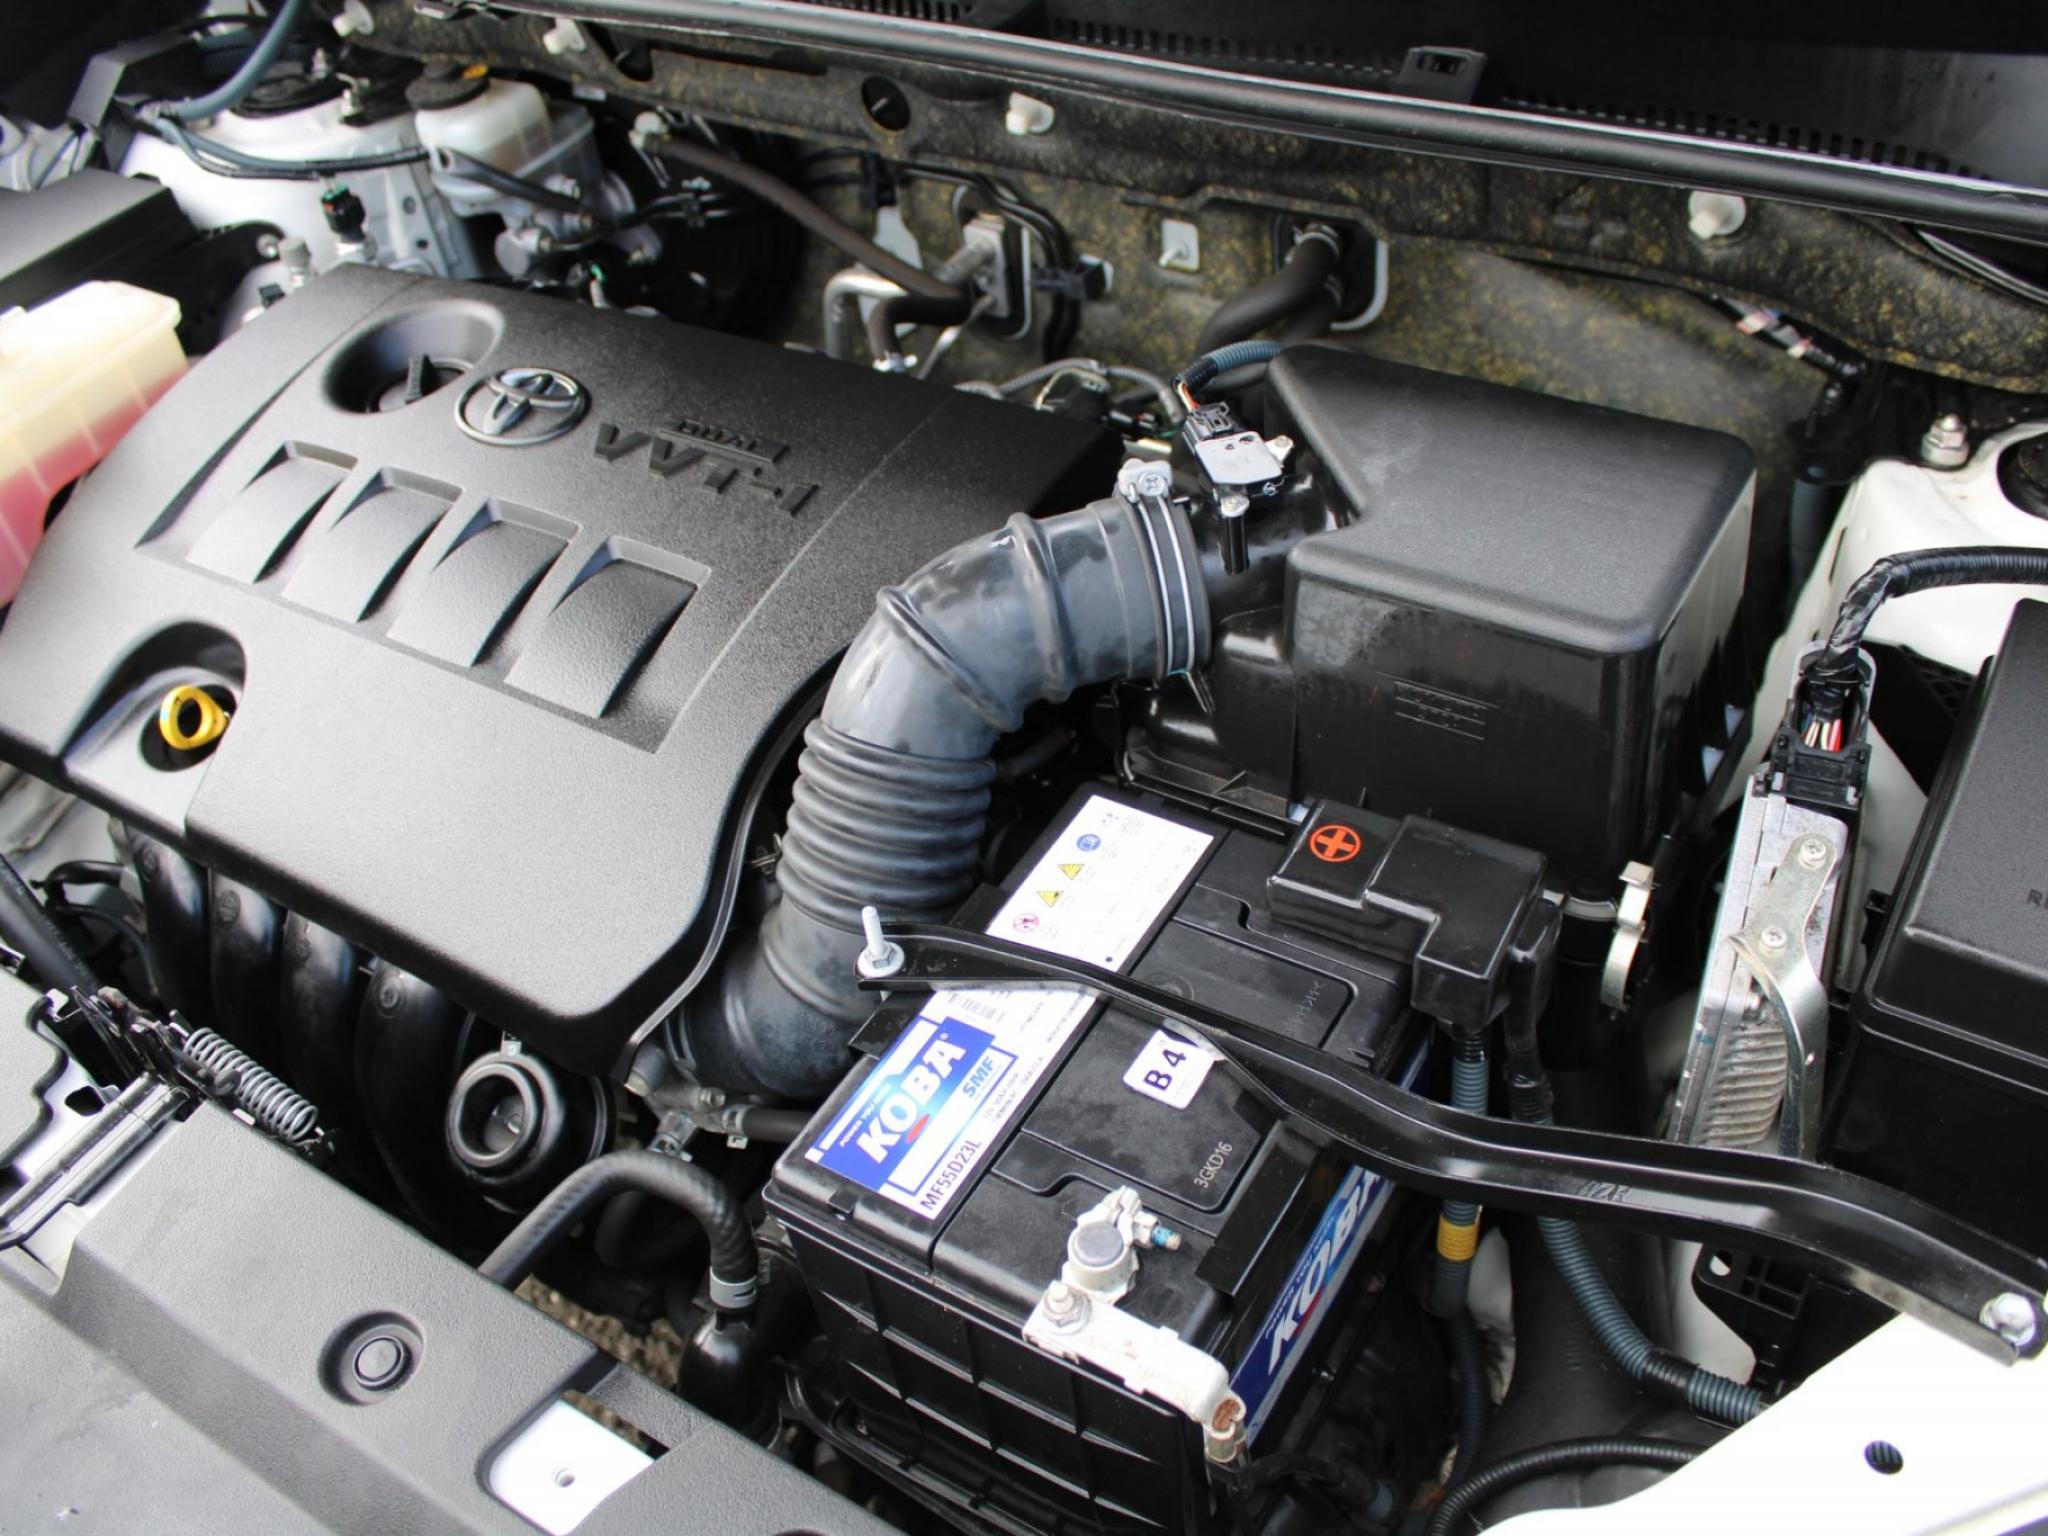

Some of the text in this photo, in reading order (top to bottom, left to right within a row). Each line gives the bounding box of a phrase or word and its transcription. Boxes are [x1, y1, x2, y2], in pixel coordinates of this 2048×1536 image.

[855, 1039, 967, 1164] KOBA
[962, 1055, 995, 1098] SMF
[919, 1139, 982, 1211] MF55D23L
[1194, 1140, 1234, 1190] 3GKD16
